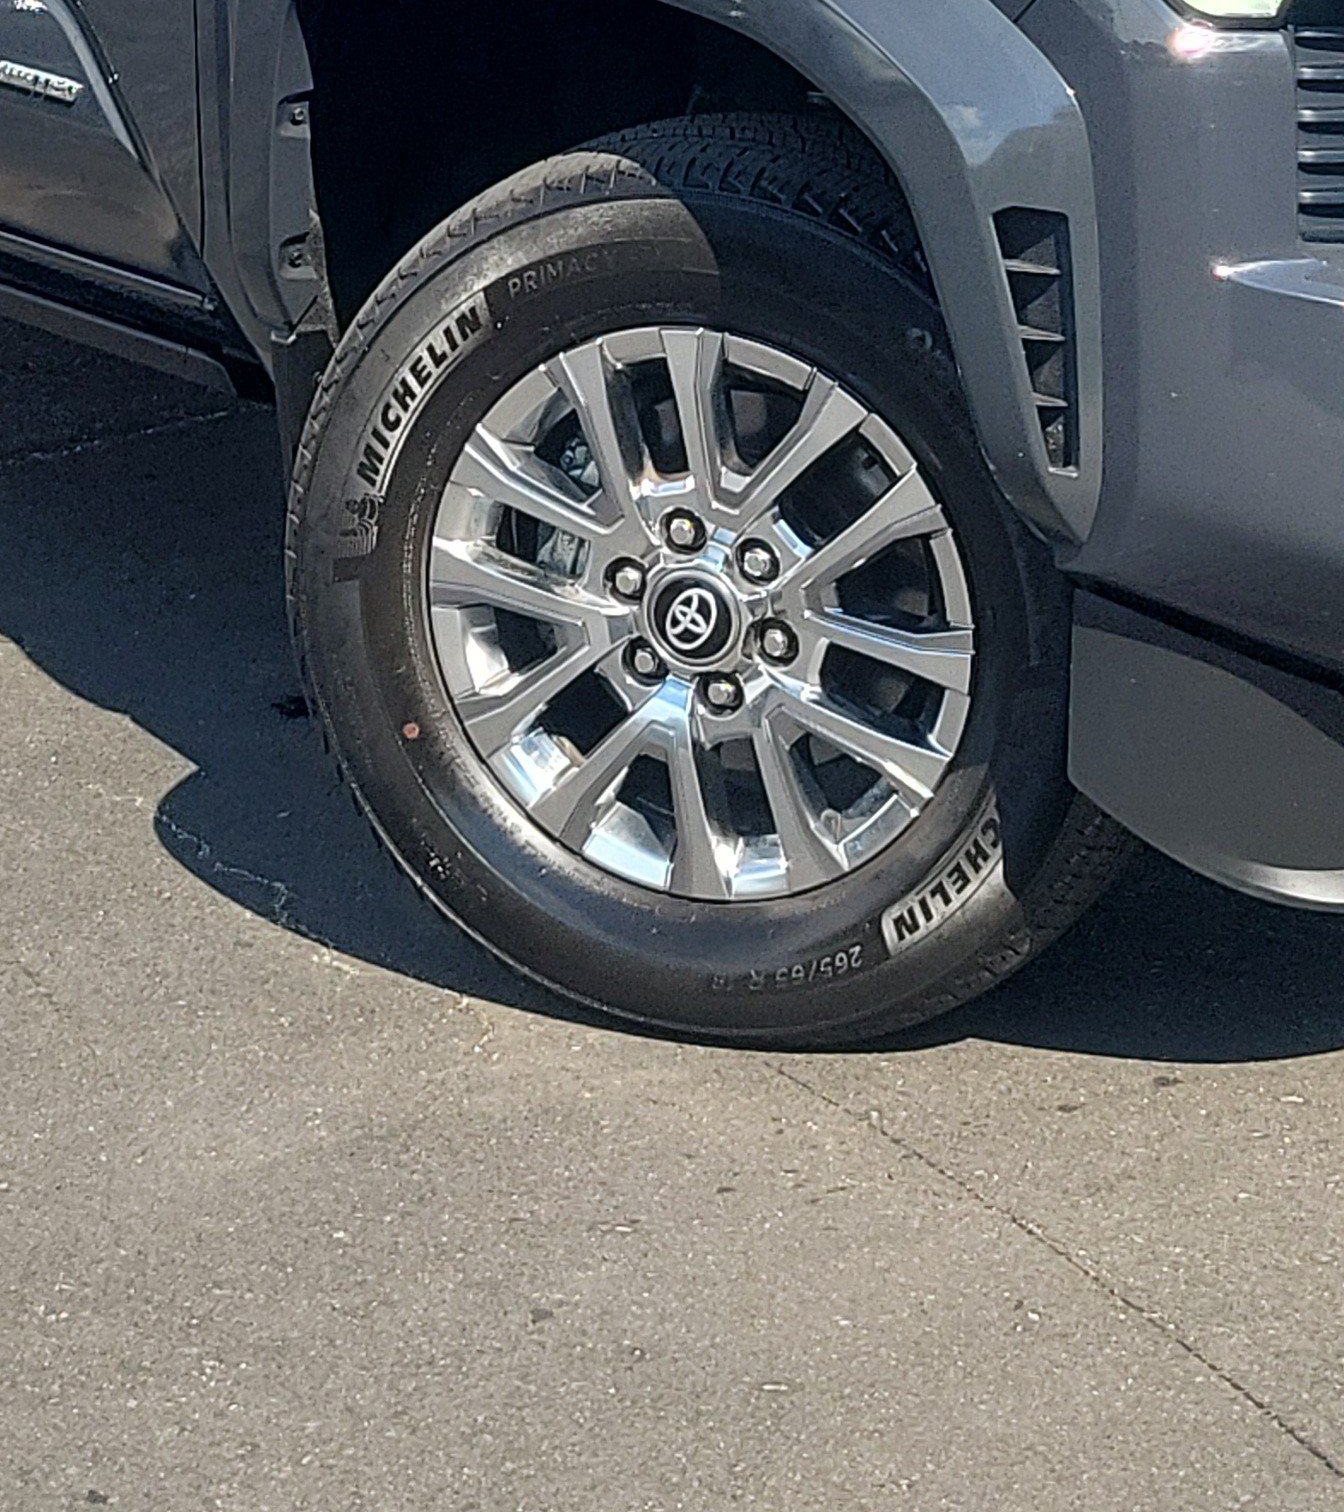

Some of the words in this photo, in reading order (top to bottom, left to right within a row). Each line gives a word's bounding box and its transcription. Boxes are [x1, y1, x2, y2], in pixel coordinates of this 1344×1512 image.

[507, 248, 618, 299] PRIMACY
[356, 304, 484, 488] MICHELIN
[892, 817, 1001, 942] CHELIN
